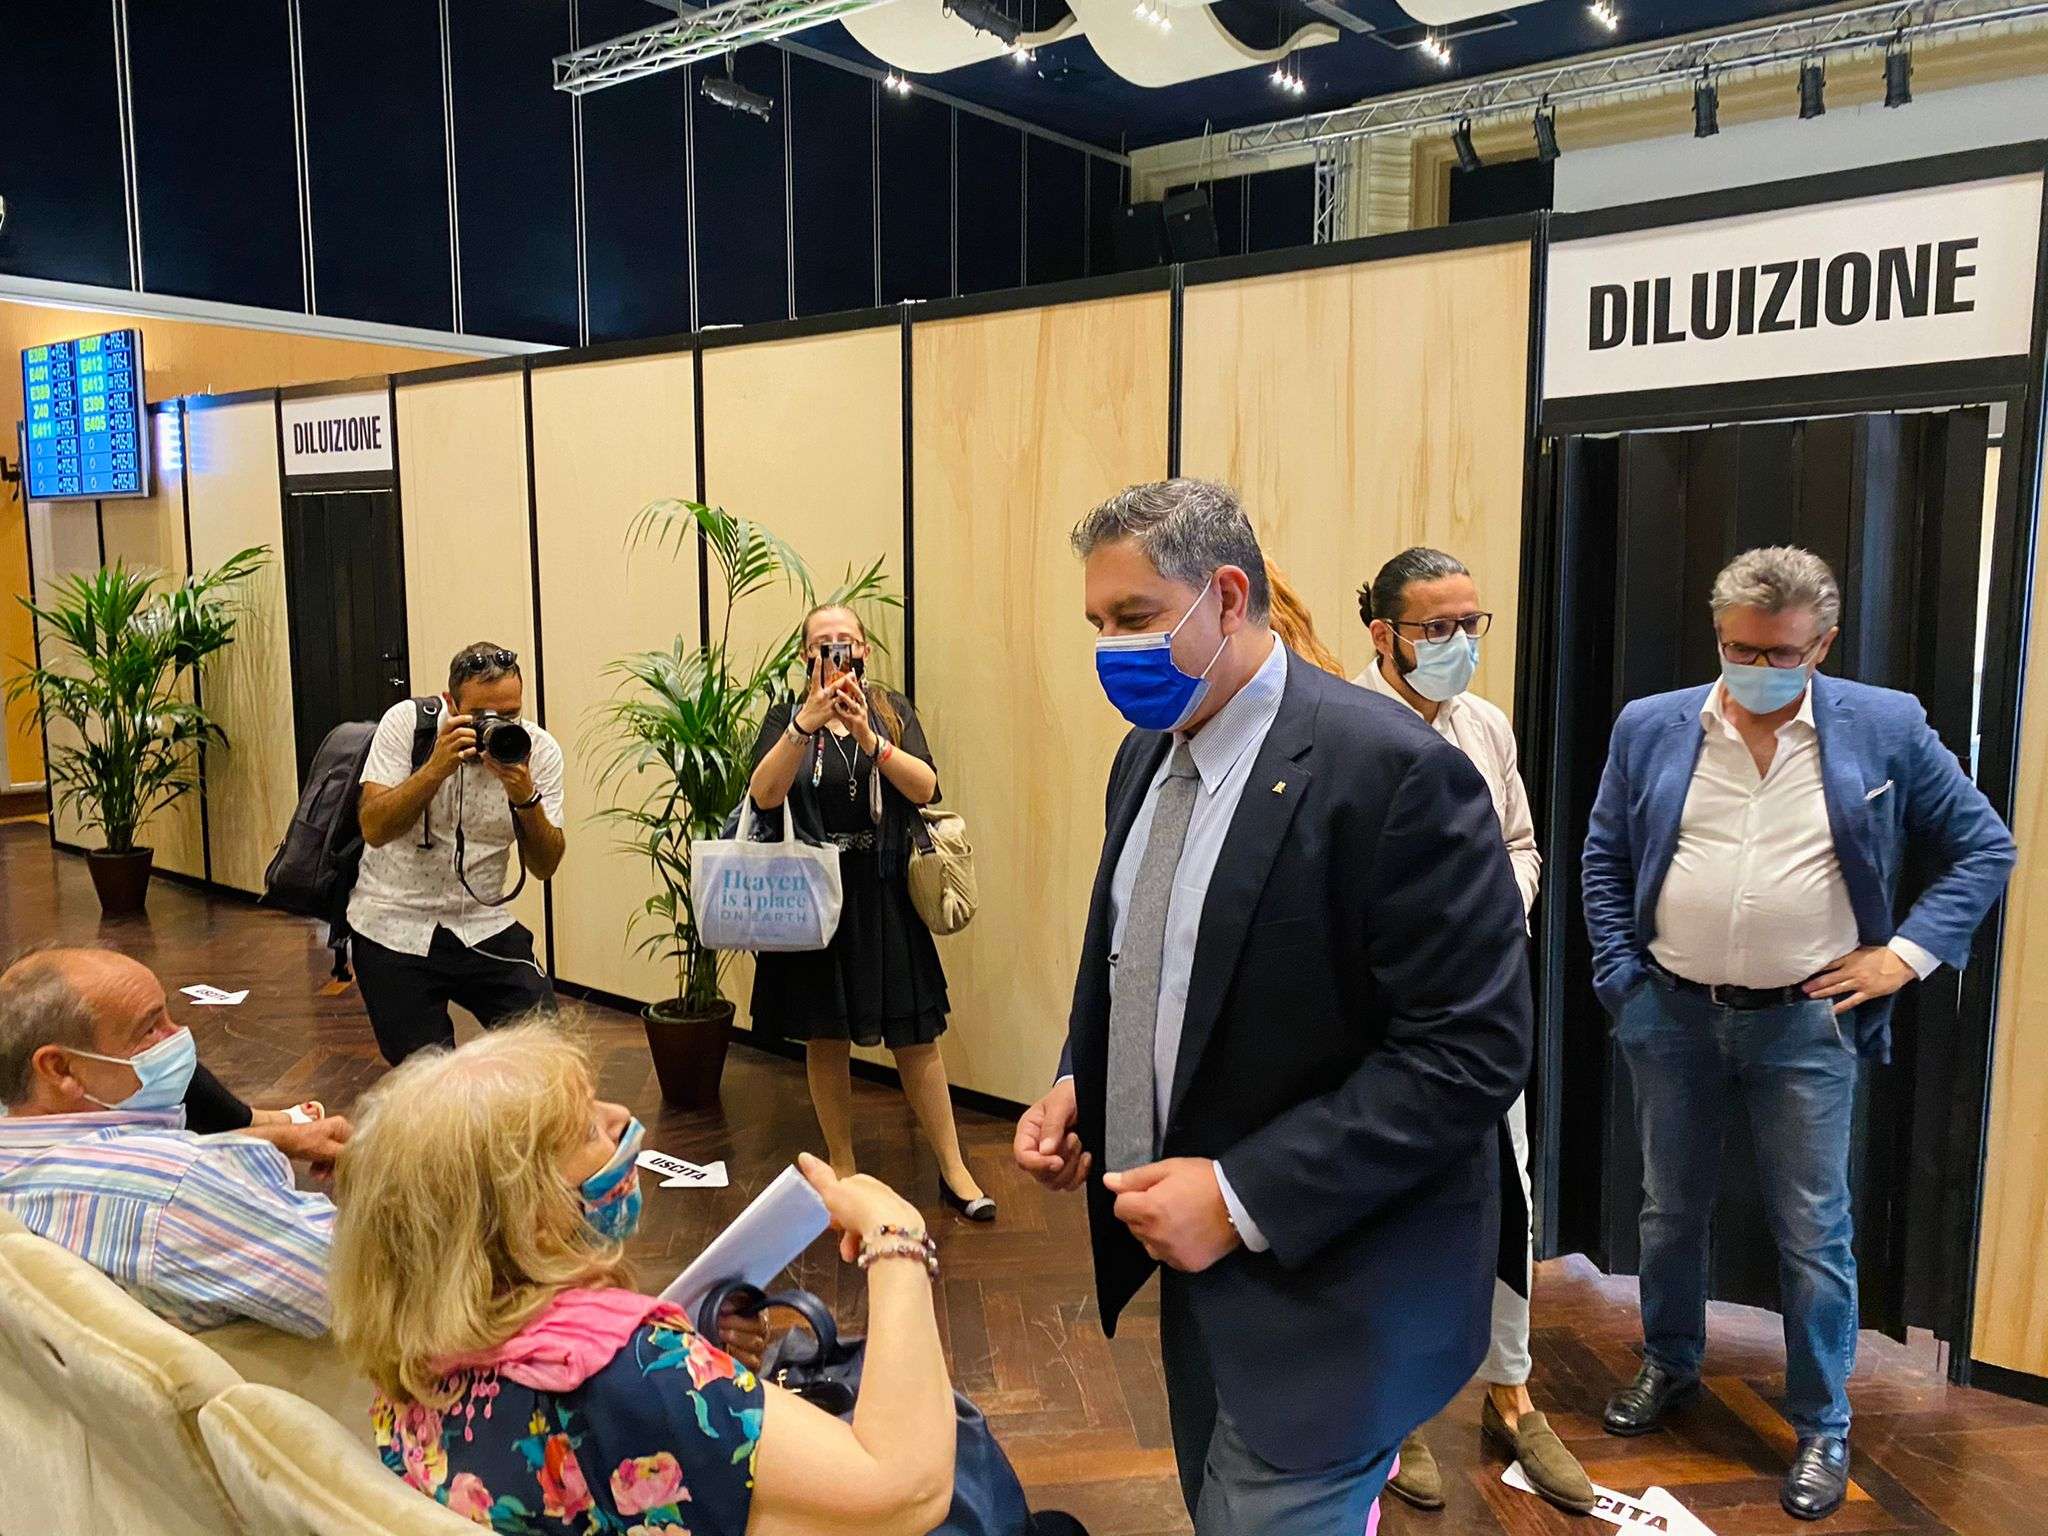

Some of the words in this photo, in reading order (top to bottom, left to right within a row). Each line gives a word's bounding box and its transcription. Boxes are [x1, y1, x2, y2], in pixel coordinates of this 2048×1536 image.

[1588, 237, 1979, 351] DILUIZIONE
[293, 415, 382, 455] DILUIZIONE
[723, 869, 806, 892] Heaven
[722, 888, 737, 907] is
[743, 895, 752, 907] a
[756, 890, 806, 912] place
[720, 911, 744, 921] ON
[751, 911, 807, 923] EARTH
[649, 1157, 708, 1181] USCITA
[1594, 1494, 1669, 1532] CITA
